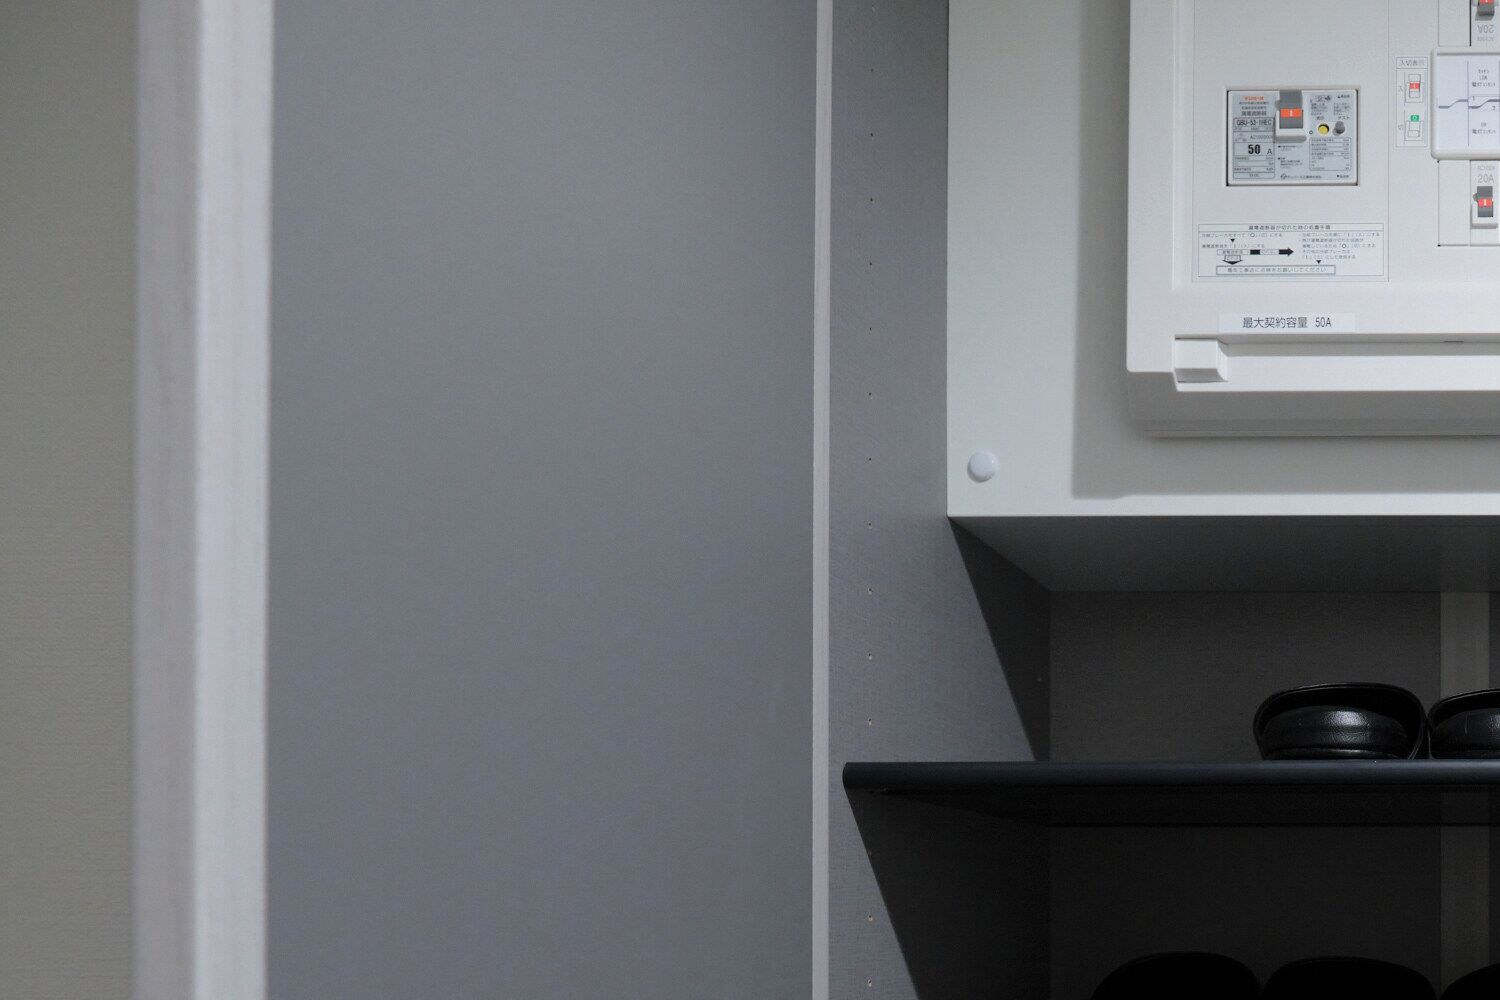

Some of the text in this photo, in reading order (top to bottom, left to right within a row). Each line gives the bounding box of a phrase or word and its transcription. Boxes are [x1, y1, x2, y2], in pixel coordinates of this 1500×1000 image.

[1477, 24, 1494, 33] 20A
[1248, 144, 1261, 155] 50
[1477, 174, 1494, 183] 20A
[1242, 316, 1332, 329] 最大契約容量 50A
